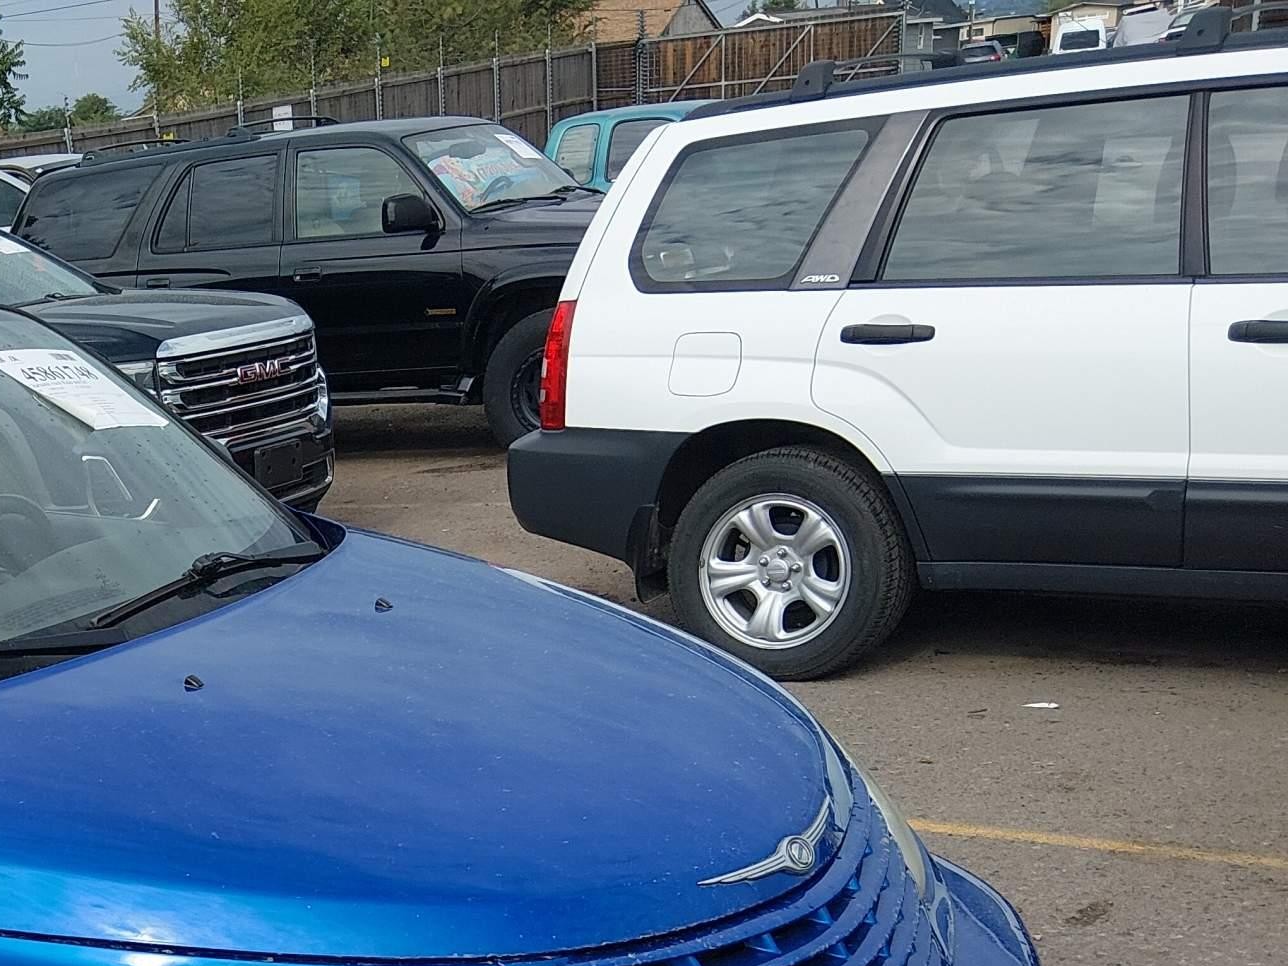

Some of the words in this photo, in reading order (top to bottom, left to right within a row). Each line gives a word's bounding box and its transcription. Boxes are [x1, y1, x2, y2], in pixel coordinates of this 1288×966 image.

[800, 274, 840, 284] AWD
[20, 364, 100, 383] 45861748
[237, 356, 296, 385] GMC
